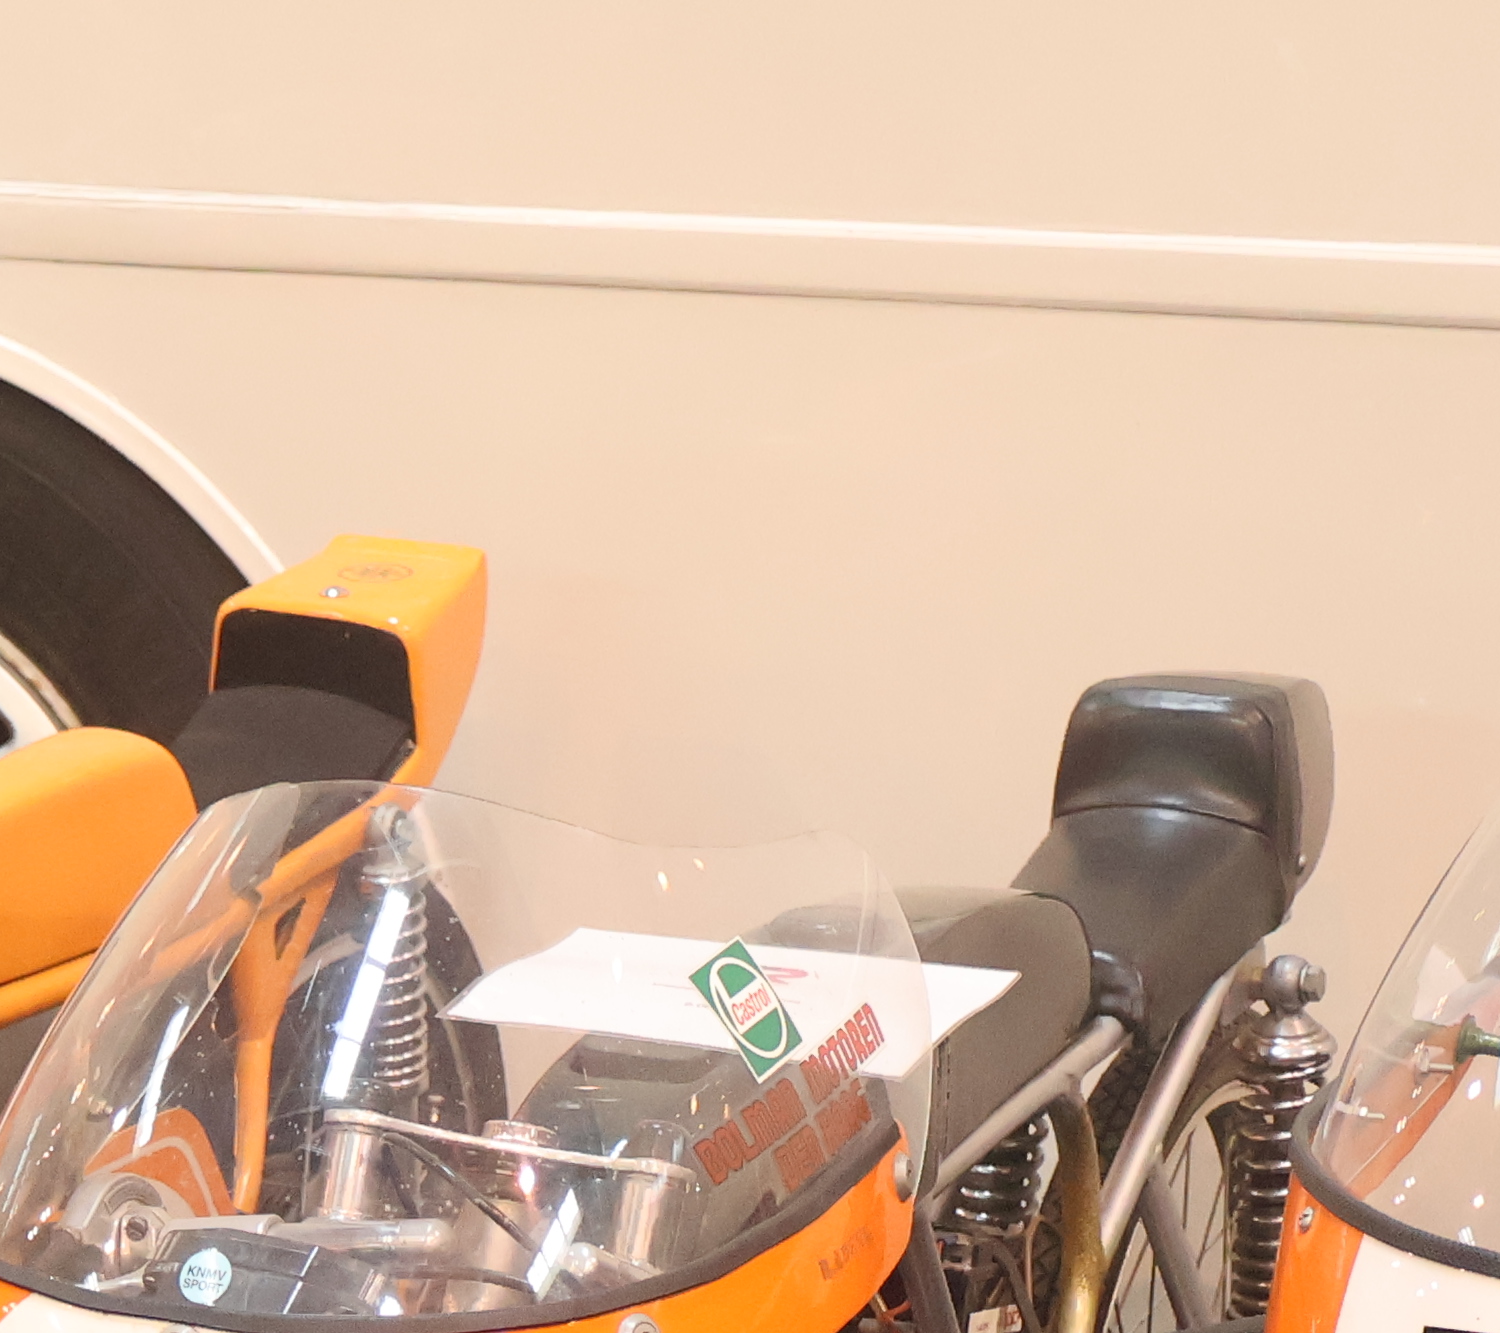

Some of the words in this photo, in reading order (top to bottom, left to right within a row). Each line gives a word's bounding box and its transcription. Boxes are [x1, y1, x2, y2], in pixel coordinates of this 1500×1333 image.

[731, 984, 772, 1027] Castrol
[798, 1002, 885, 1105] MOTOREN
[182, 1278, 224, 1294] SPORT
[186, 1265, 228, 1281] KNMV
